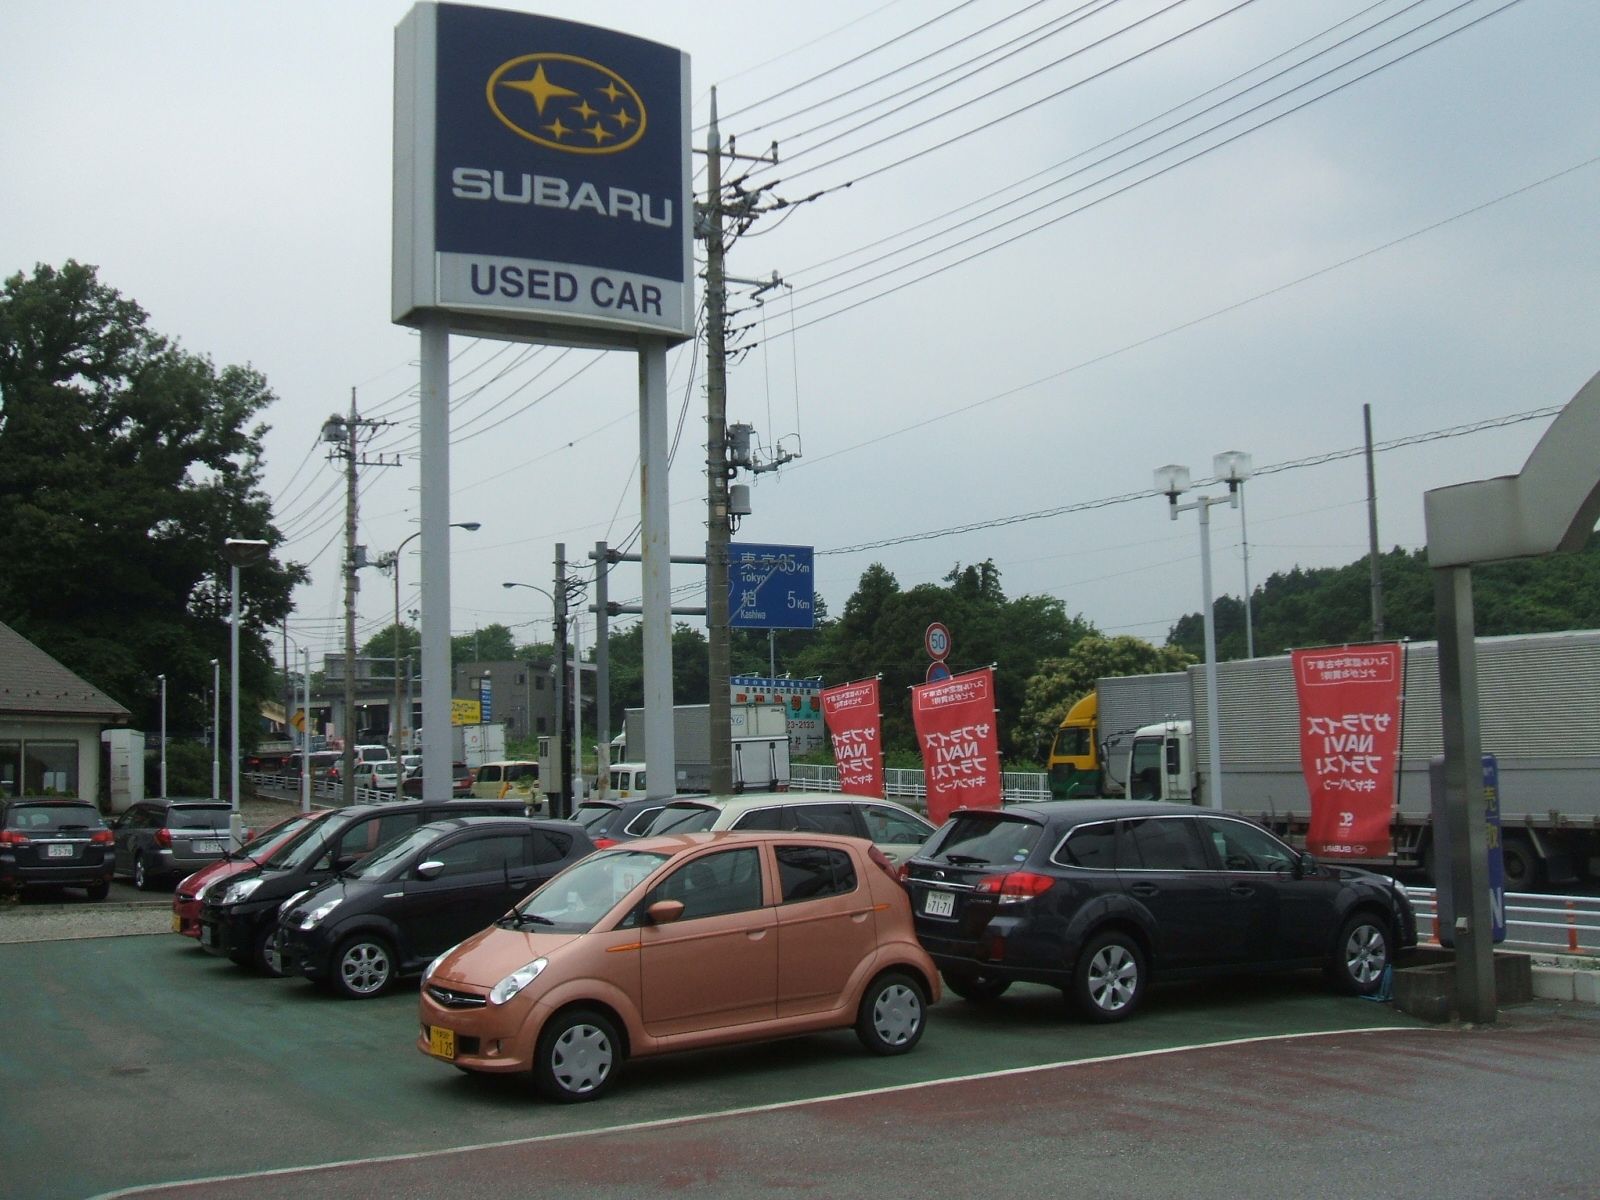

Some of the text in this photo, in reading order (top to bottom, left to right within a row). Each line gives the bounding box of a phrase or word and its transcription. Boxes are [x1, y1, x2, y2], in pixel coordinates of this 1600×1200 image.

[451, 167, 673, 228] SUBARU
[470, 263, 662, 316] USED CAR
[740, 552, 776, 571] 東京
[740, 572, 767, 584] Tokyo
[740, 589, 757, 607] 柏
[740, 609, 766, 620] Kashiwa
[931, 633, 945, 650] 50
